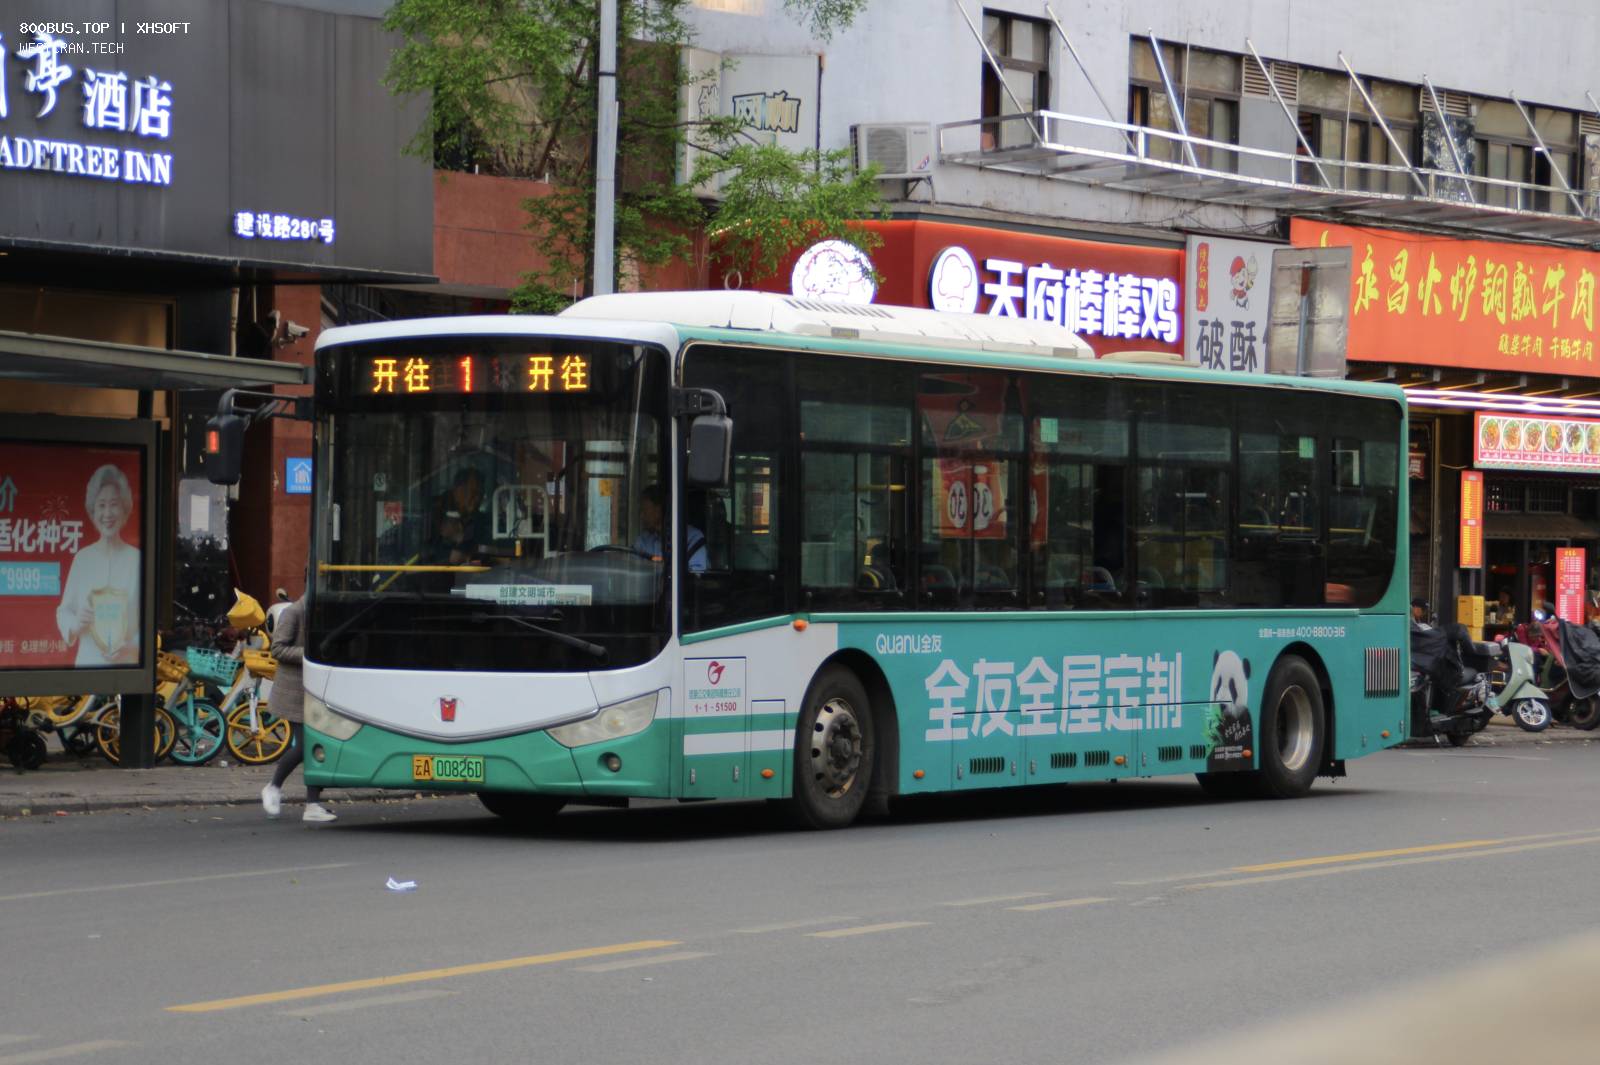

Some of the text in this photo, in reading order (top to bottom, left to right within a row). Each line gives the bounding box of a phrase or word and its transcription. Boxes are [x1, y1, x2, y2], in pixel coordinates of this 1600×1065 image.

[0, 32, 172, 137] 亭酒店
[124, 150, 171, 184] INN
[237, 211, 334, 243] 建设路280号
[984, 258, 1178, 343] 天府棒棒鸡
[1320, 231, 1595, 331] 永昌火炉铜瓢牛肉
[373, 355, 588, 393] 开往 1 开往
[1196, 317, 1268, 373] 破酥
[925, 652, 1182, 741] 全友全屋定制
